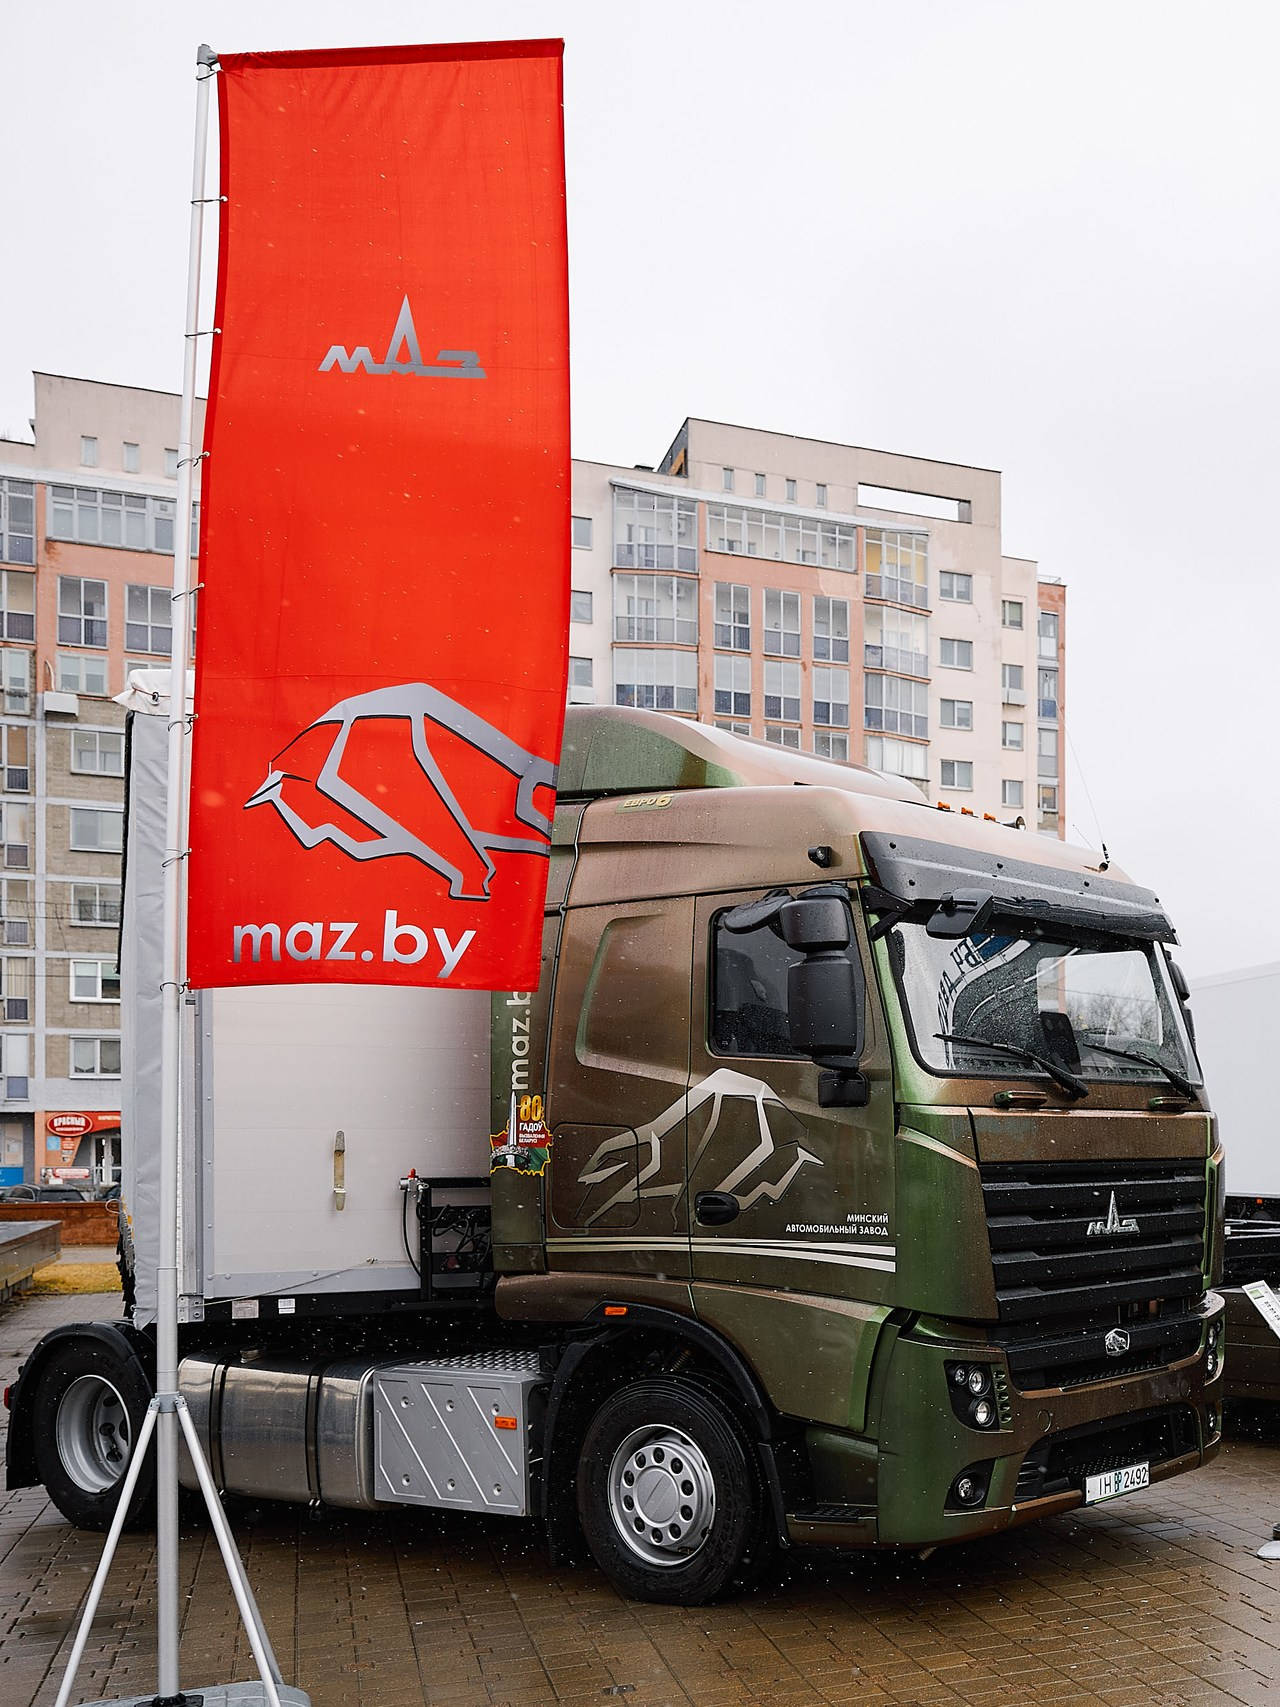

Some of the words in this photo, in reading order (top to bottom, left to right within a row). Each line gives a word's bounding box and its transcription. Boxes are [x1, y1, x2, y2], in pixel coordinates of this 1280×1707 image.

[233, 909, 477, 979] maz.by
[506, 991, 532, 1090] maz.b
[519, 1094, 543, 1122] 80
[785, 1223, 857, 1234] АВТОМОБИЛЬНЫЙ
[859, 1226, 889, 1236] ЗАВОД
[846, 1213, 889, 1224] МИНСКИЙ
[1124, 1466, 1148, 1489] 2492
